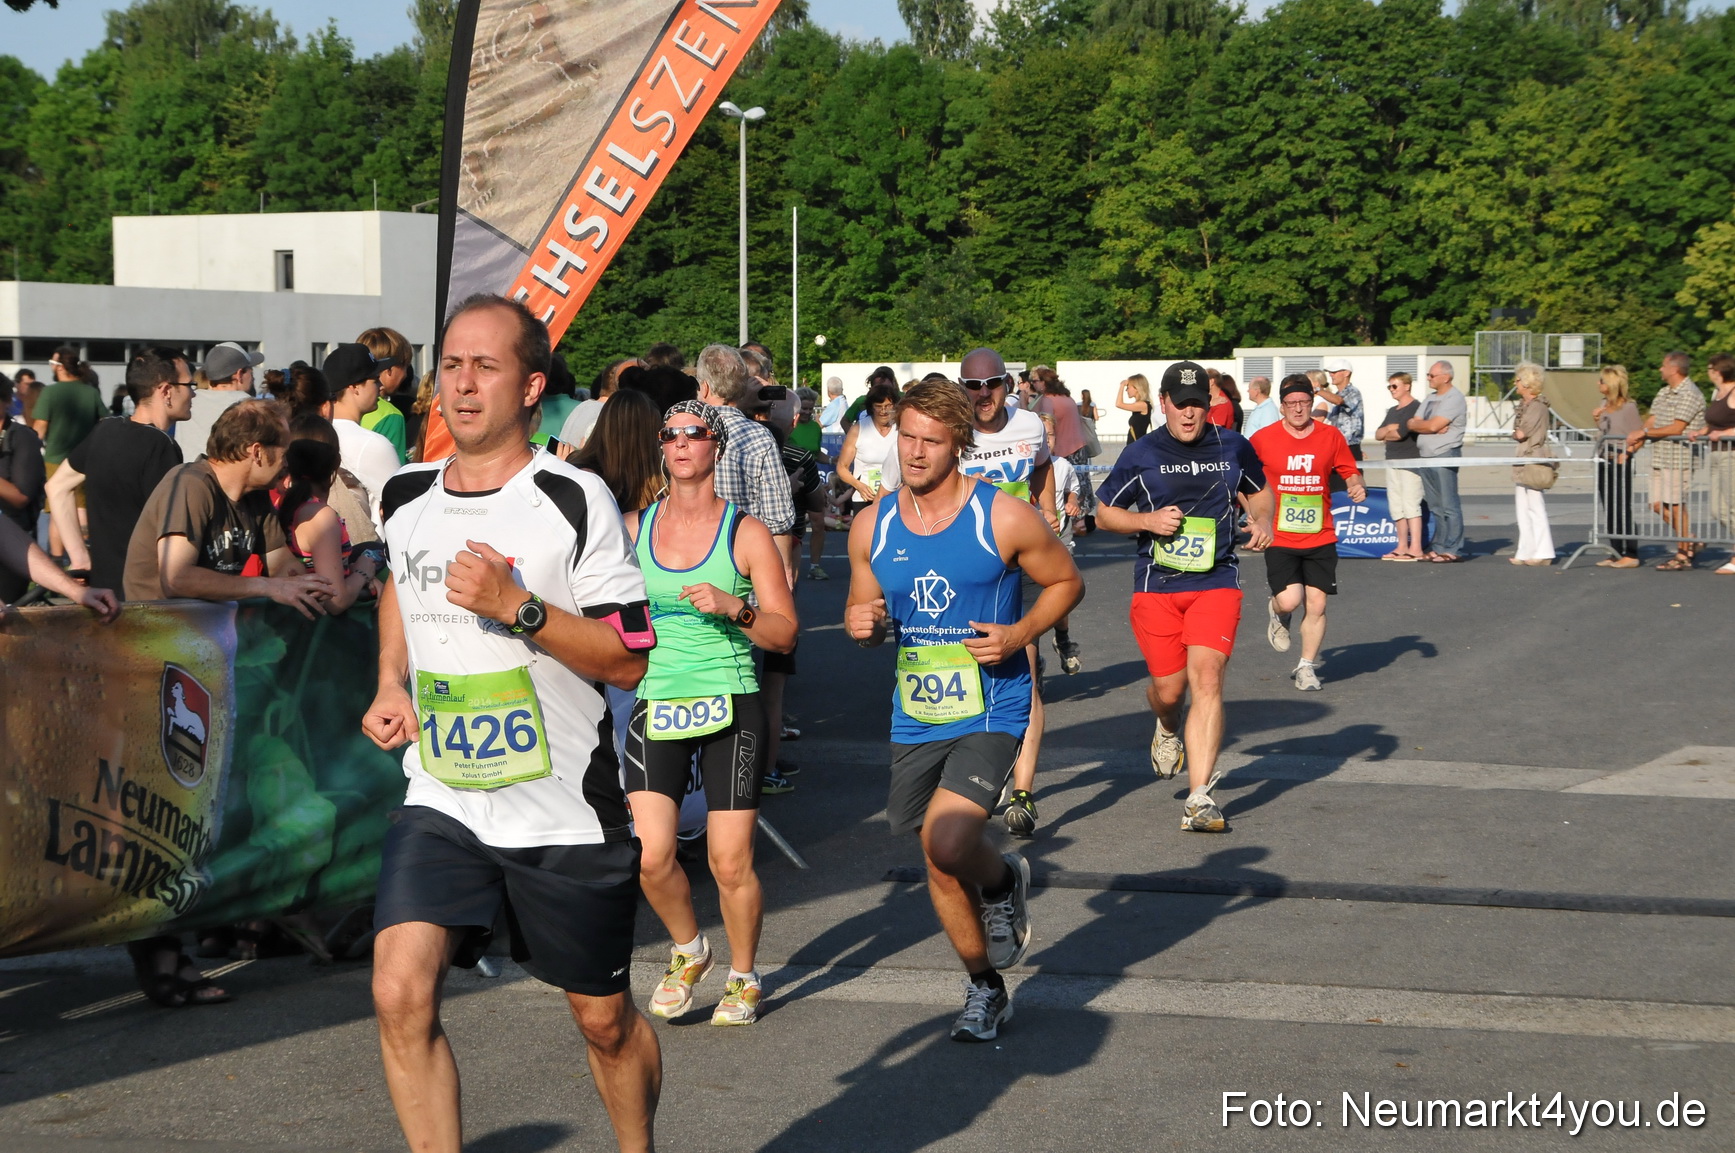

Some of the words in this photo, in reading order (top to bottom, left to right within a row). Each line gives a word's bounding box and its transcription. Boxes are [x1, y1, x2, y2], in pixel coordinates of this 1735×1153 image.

[965, 447, 1014, 461] expert
[965, 458, 1034, 483] TeVi
[1160, 463, 1191, 474] EURO
[1200, 461, 1231, 473] POLES
[1286, 453, 1315, 474] MRT
[1279, 474, 1321, 485] MEIER
[443, 507, 488, 516] STANNO
[1285, 507, 1316, 524] 848
[1335, 518, 1397, 536] Fisch
[1342, 535, 1399, 544] AUTOMOB
[410, 613, 477, 624] SPORTGEIST
[906, 671, 967, 704] 294
[652, 695, 729, 732] 5093
[423, 709, 538, 760] 1426
[173, 752, 195, 778] 1628
[471, 760, 508, 769] Fuhrmann
[737, 729, 757, 799] 2XU
[481, 770, 503, 779] GmbH
